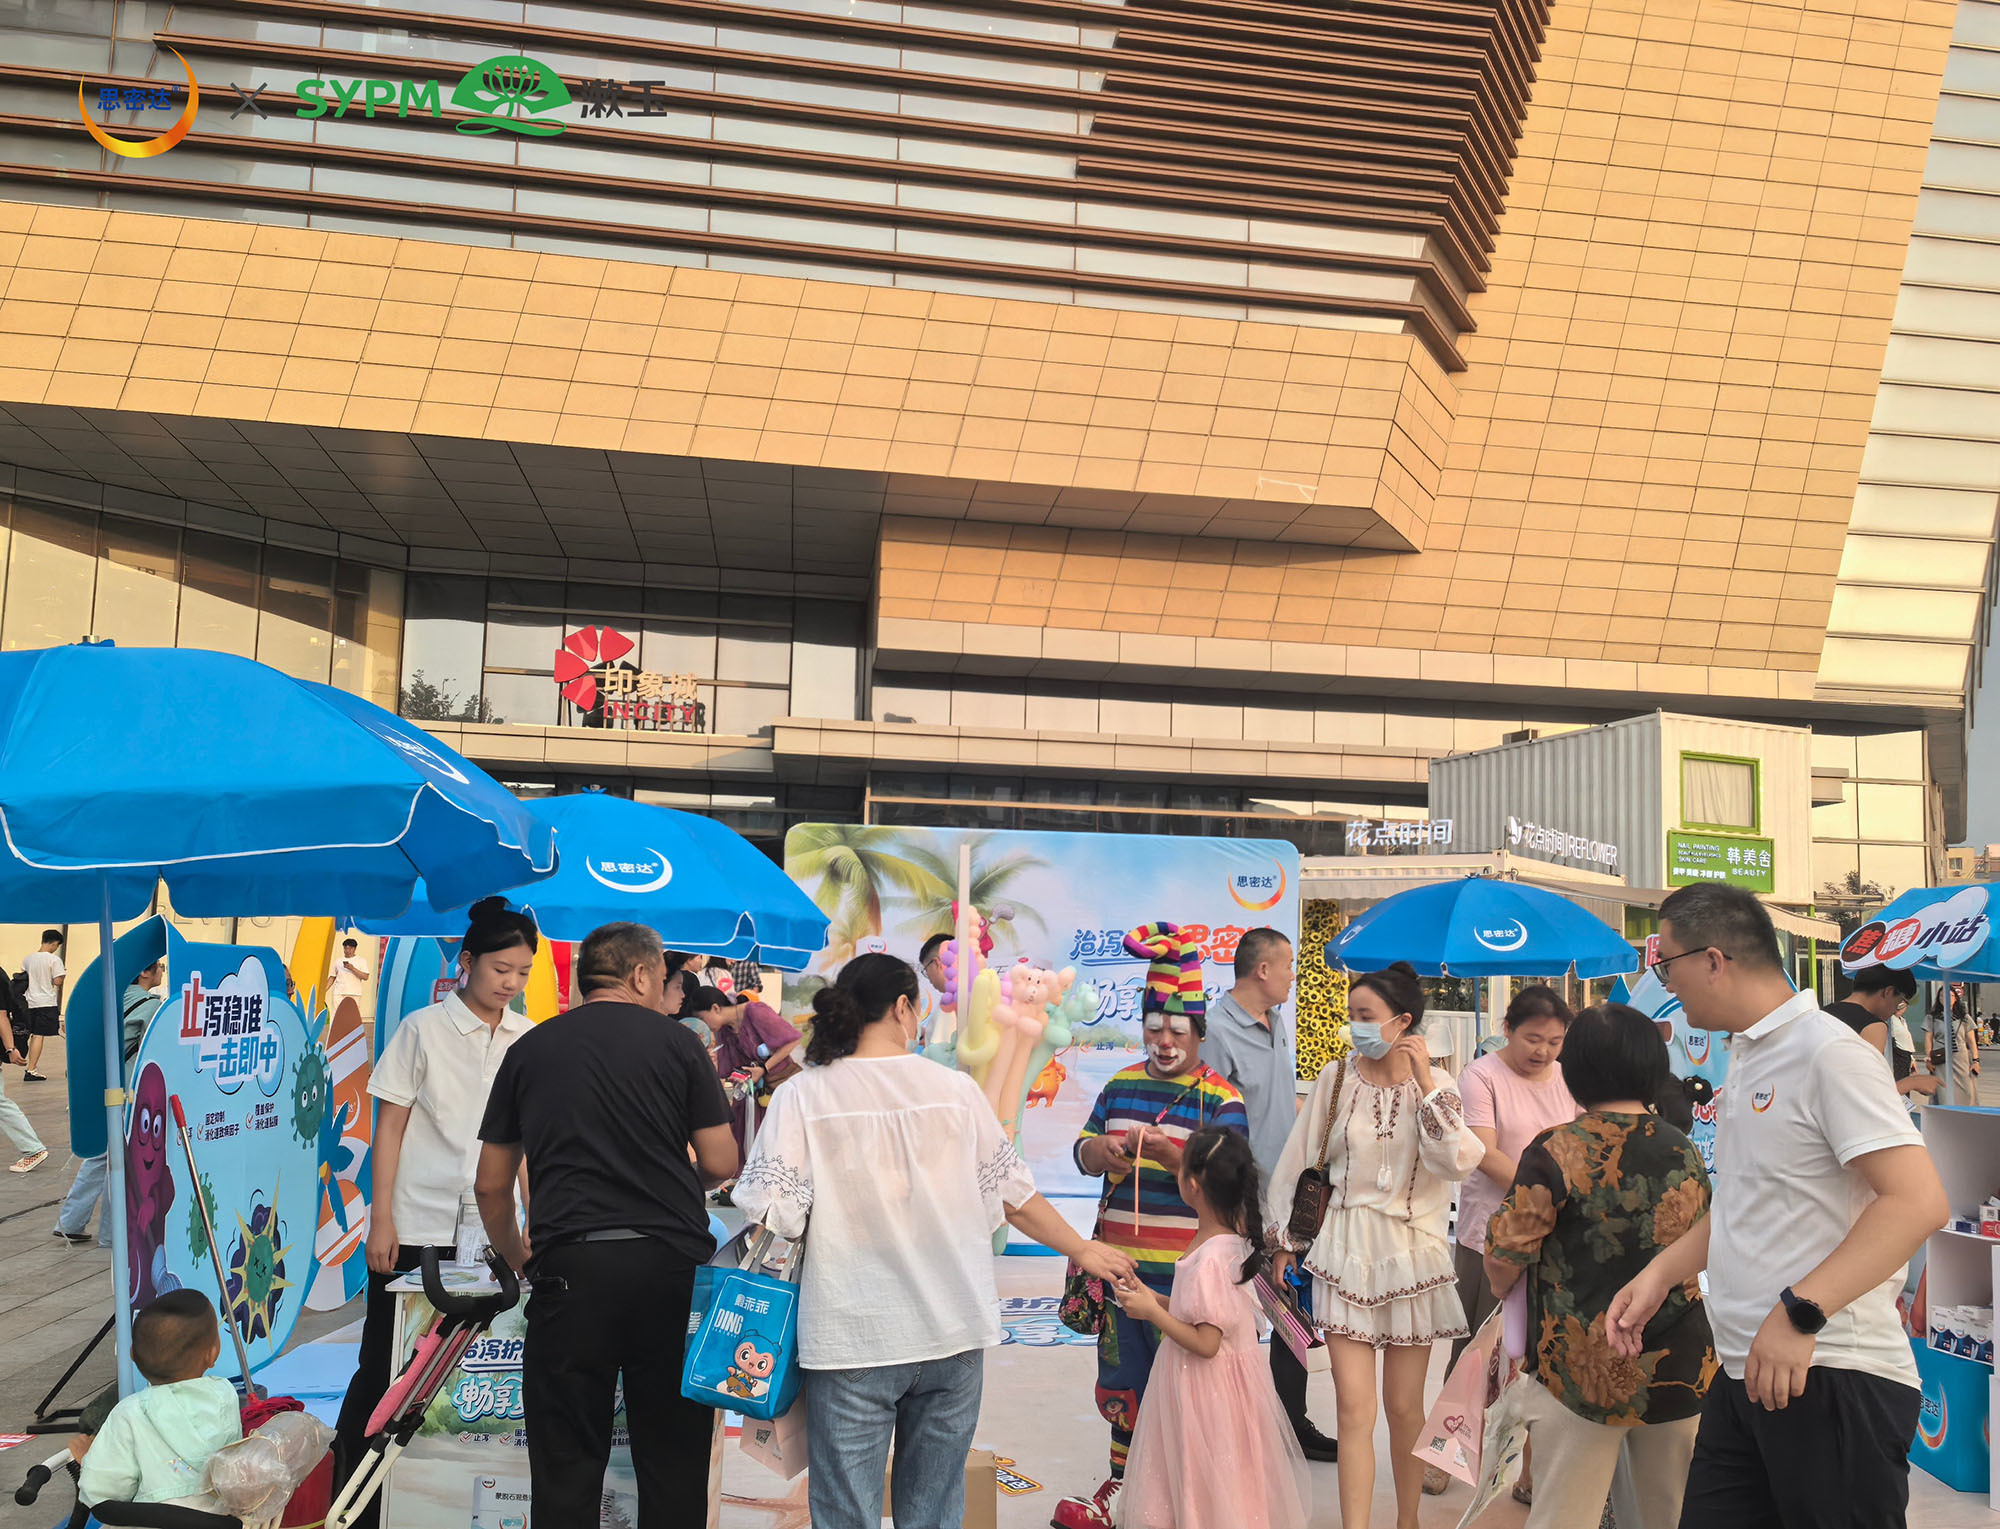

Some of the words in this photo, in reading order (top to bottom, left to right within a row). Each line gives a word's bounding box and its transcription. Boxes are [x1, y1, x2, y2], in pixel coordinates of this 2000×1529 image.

[604, 663, 698, 700] 印象城
[603, 700, 697, 723] INCITY
[1345, 819, 1453, 847] 花点时间
[601, 861, 654, 874] 思密达
[1732, 868, 1767, 877] BEAUTY
[1237, 875, 1273, 888] 思密达
[180, 978, 262, 1038] 止泻稳准
[201, 1034, 277, 1078] 一击即中
[714, 1308, 744, 1335] DING
[474, 1434, 489, 1442] 止泻
